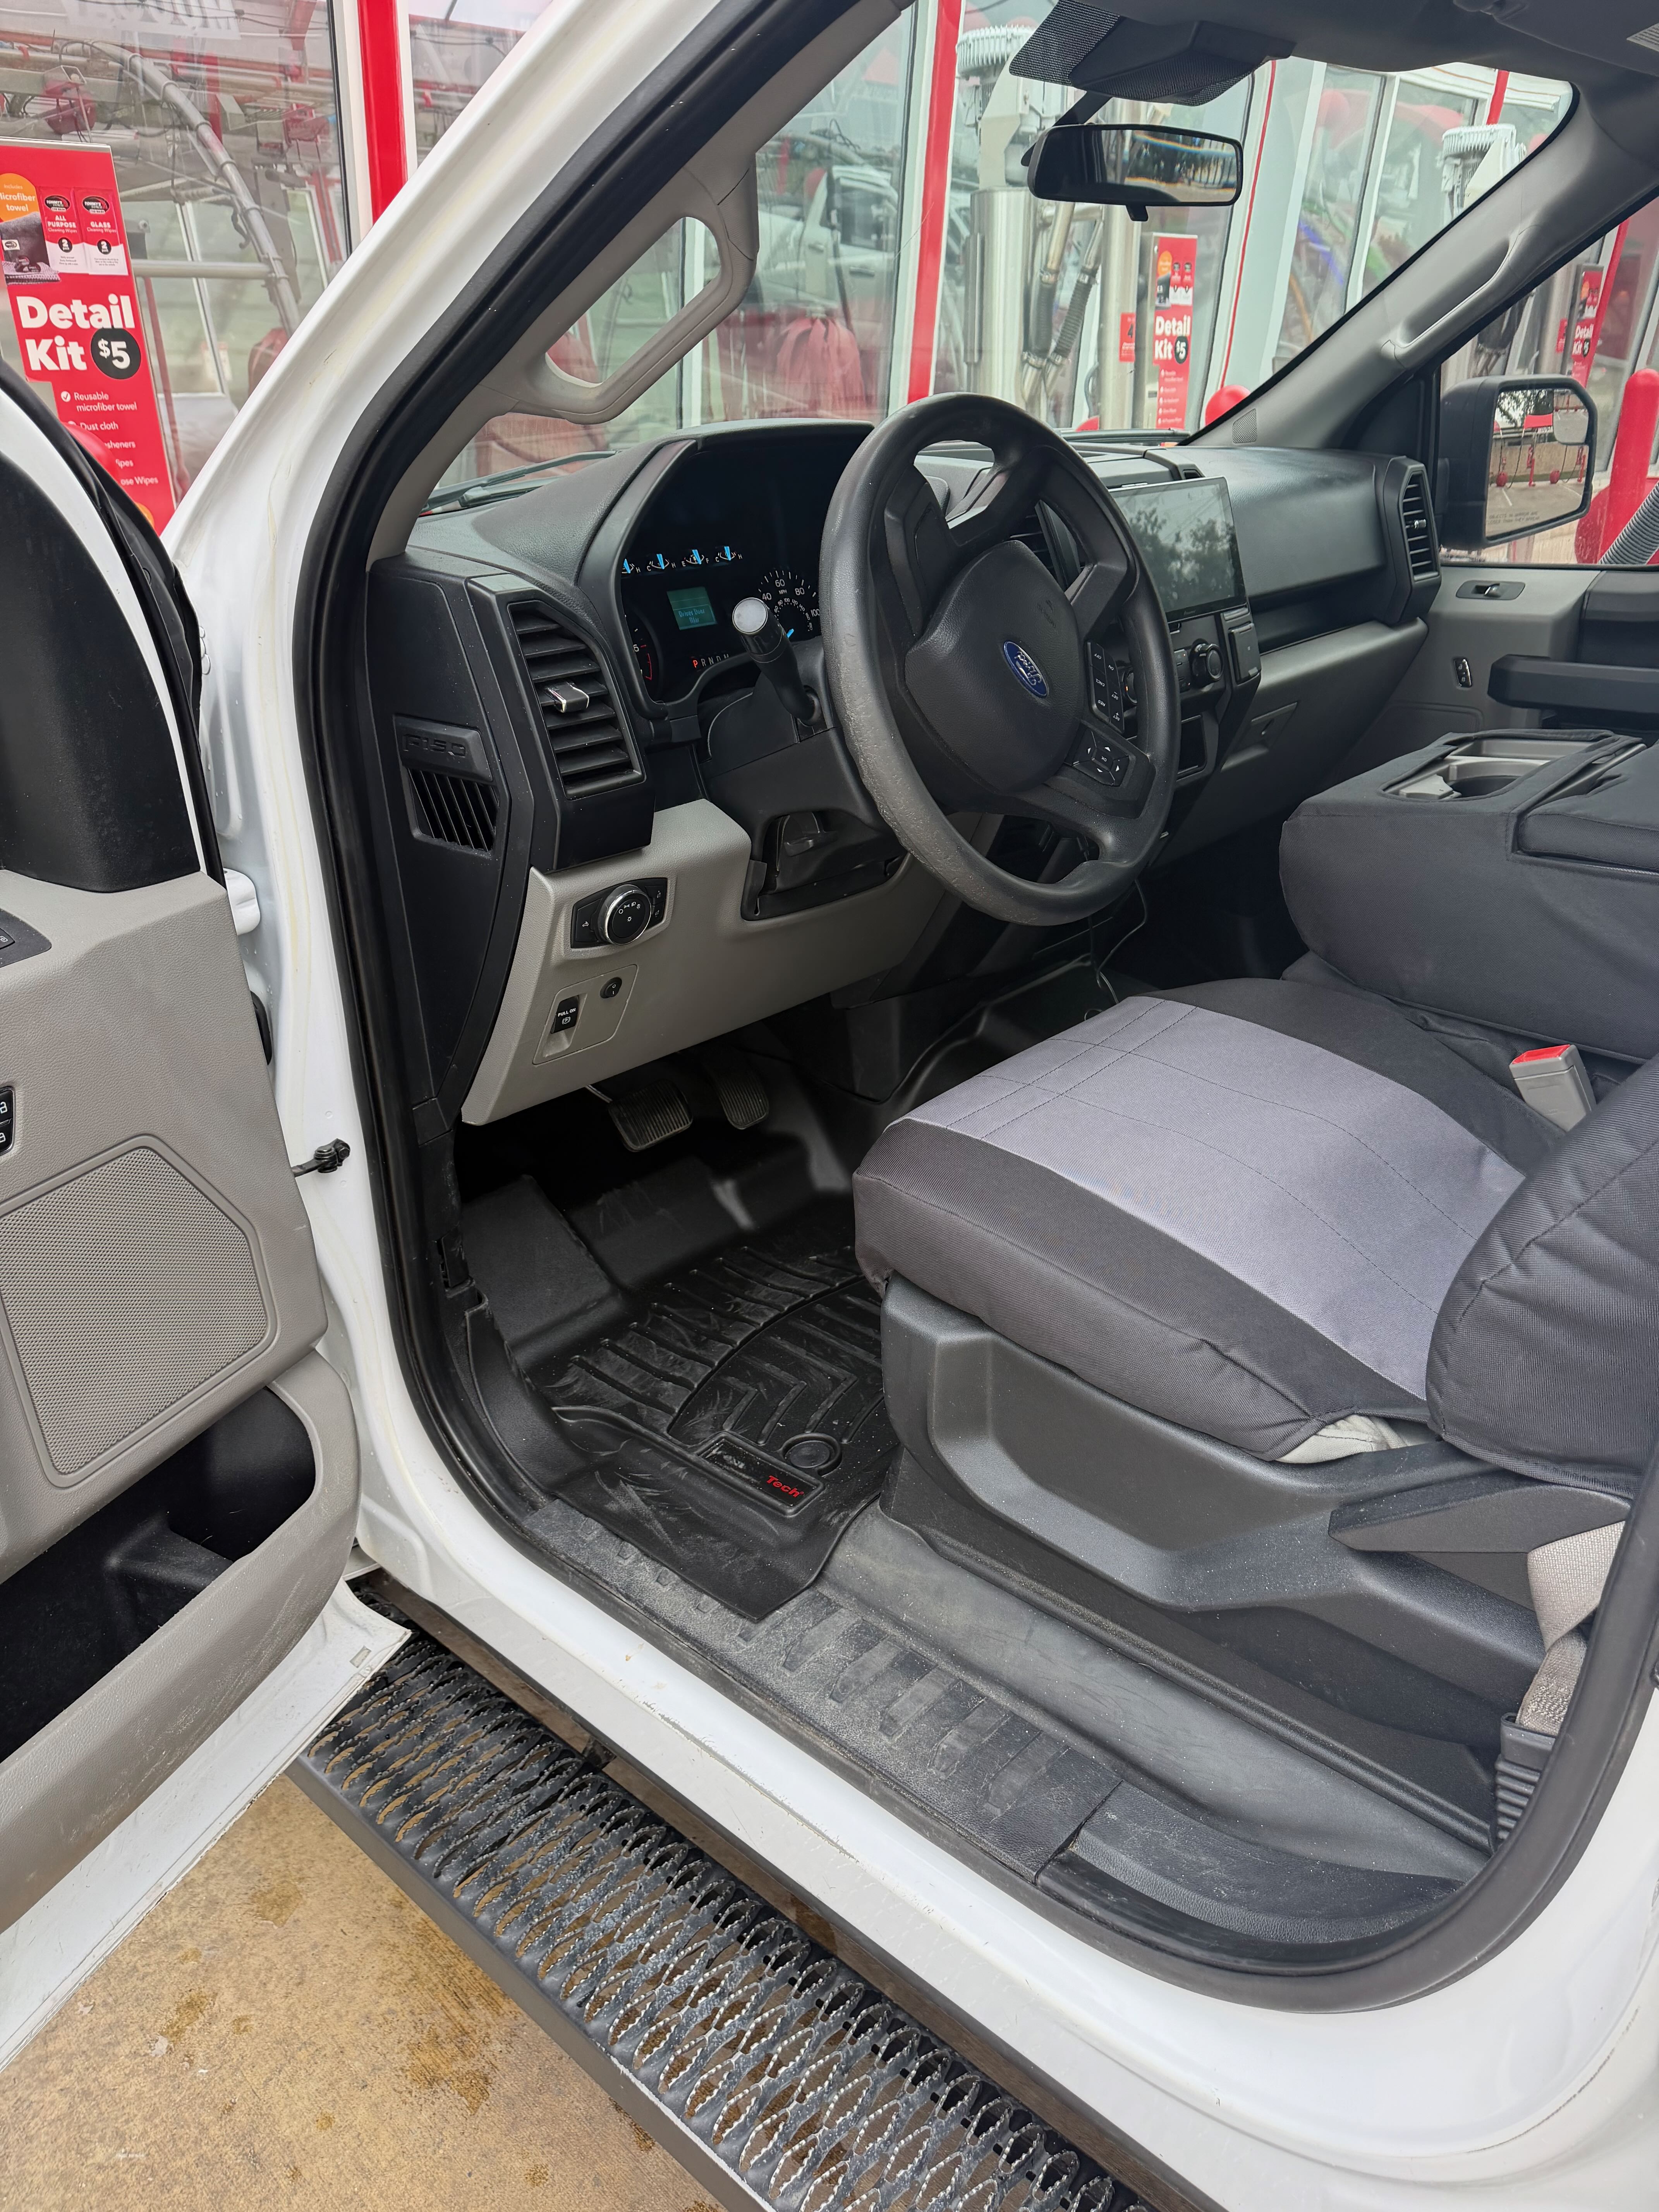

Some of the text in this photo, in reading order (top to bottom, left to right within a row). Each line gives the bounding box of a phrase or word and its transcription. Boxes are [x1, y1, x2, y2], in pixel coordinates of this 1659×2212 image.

[6, 204, 29, 212] towel
[16, 293, 135, 329] Detail
[1155, 315, 1191, 336] Detail
[1575, 324, 1594, 339] Detail
[25, 335, 130, 370] Kit $5
[1154, 338, 1172, 360] Kit
[1176, 340, 1186, 360] $5
[1572, 340, 1583, 355] Kit
[74, 392, 109, 401] Reusable
[76, 401, 137, 412] microfiber towel
[80, 421, 119, 431] Dust cloth
[104, 440, 136, 449] sheners
[134, 476, 158, 486] Wipes
[775, 579, 785, 587] 60
[762, 592, 772, 601] 40
[795, 587, 805, 596] 80
[811, 609, 820, 617] 100
[633, 644, 639, 652] 6
[692, 660, 698, 668] P
[701, 659, 706, 667] R
[708, 657, 714, 665] N
[1014, 651, 1042, 685] Ford
[1095, 678, 1105, 687] CNCL
[766, 1475, 800, 1498] Tech
